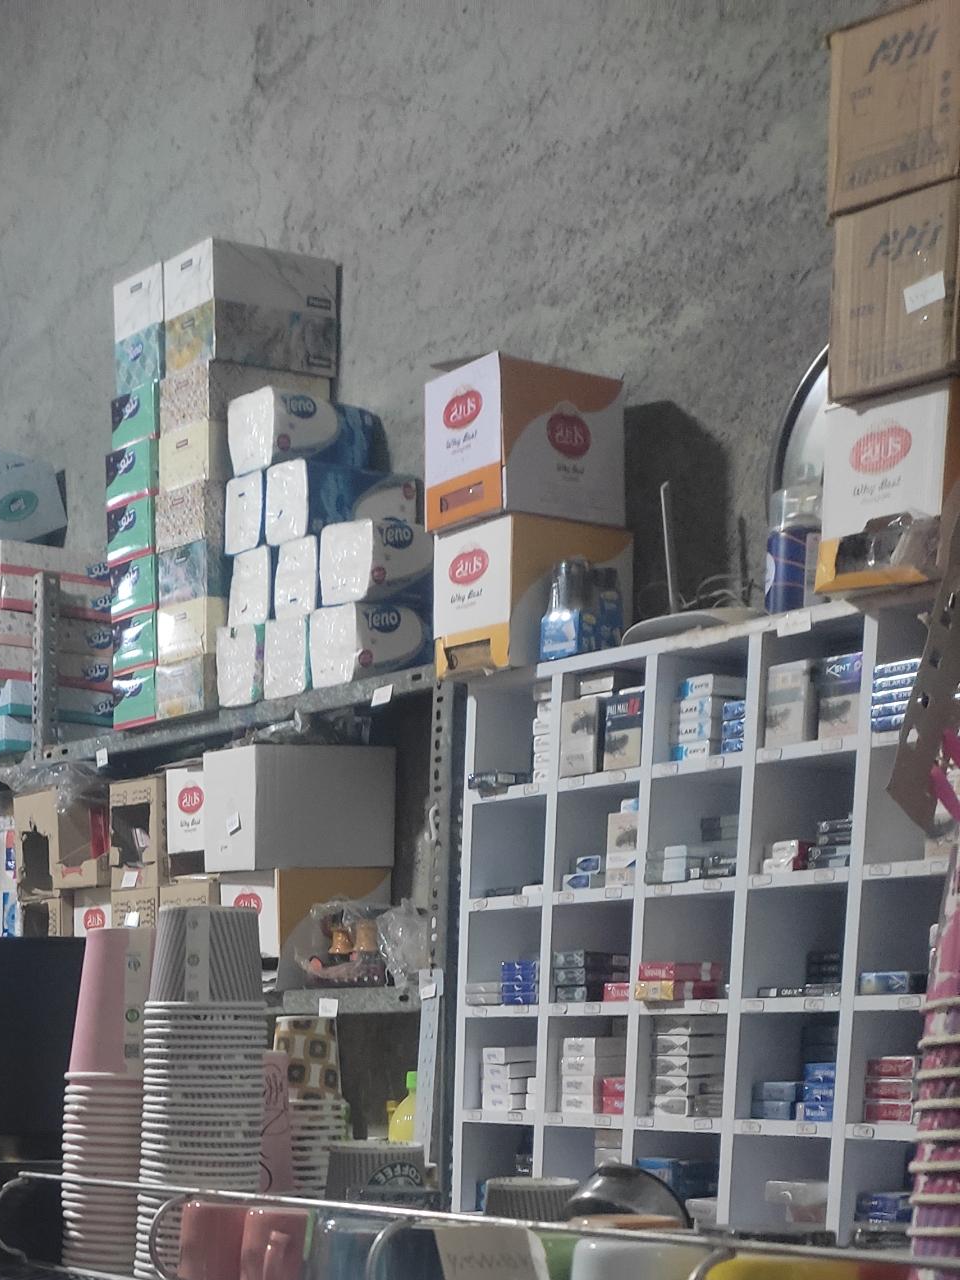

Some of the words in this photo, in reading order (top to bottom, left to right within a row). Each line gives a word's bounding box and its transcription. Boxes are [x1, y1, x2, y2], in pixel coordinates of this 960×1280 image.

[381, 526, 413, 546] Teno
[366, 609, 399, 630] Teno
[826, 662, 850, 678] KENT
[375, 1164, 422, 1185] COFFEE
